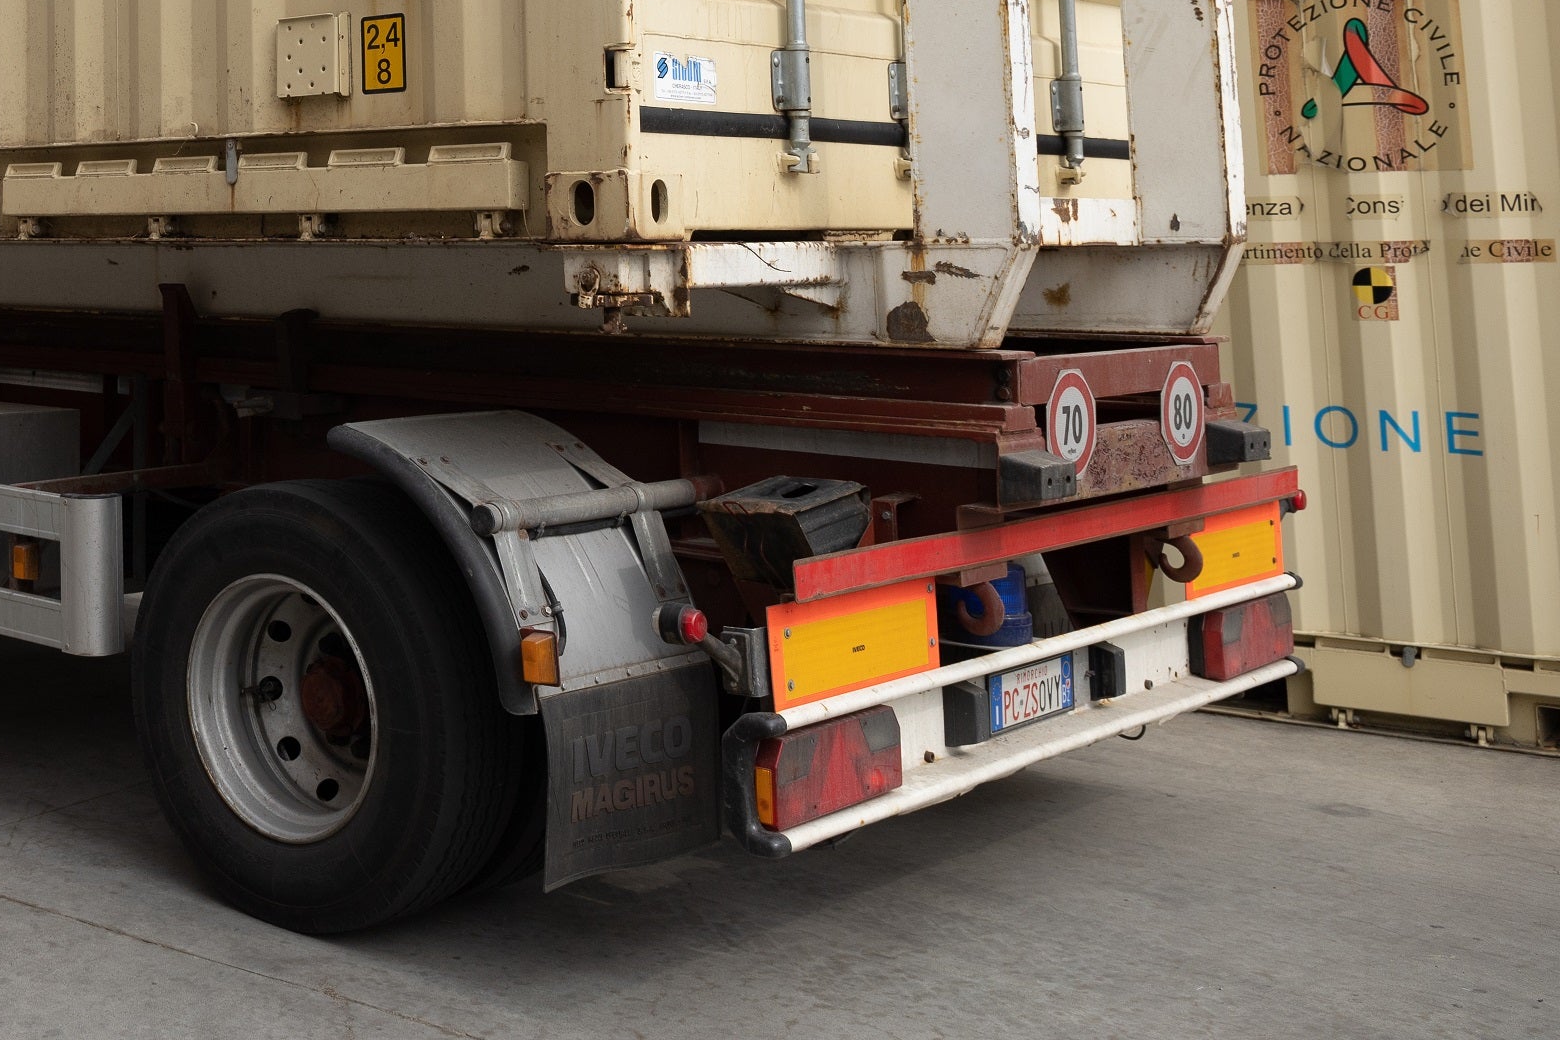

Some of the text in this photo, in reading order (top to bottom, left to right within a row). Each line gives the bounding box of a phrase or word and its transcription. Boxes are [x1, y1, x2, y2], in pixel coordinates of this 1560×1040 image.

[366, 21, 400, 54] 2,4
[1403, 7, 1461, 87] CIVILE
[376, 58, 392, 84] 8
[1246, 199, 1293, 216] enza
[1455, 193, 1490, 213] dei
[1488, 240, 1553, 258] Civile
[1358, 304, 1389, 320] CG
[1062, 404, 1083, 445] 70
[1173, 393, 1192, 431] 80
[1016, 665, 1048, 684] RIMORCHIO
[572, 715, 691, 784] IVECO
[571, 765, 696, 824] MAGIRUS
